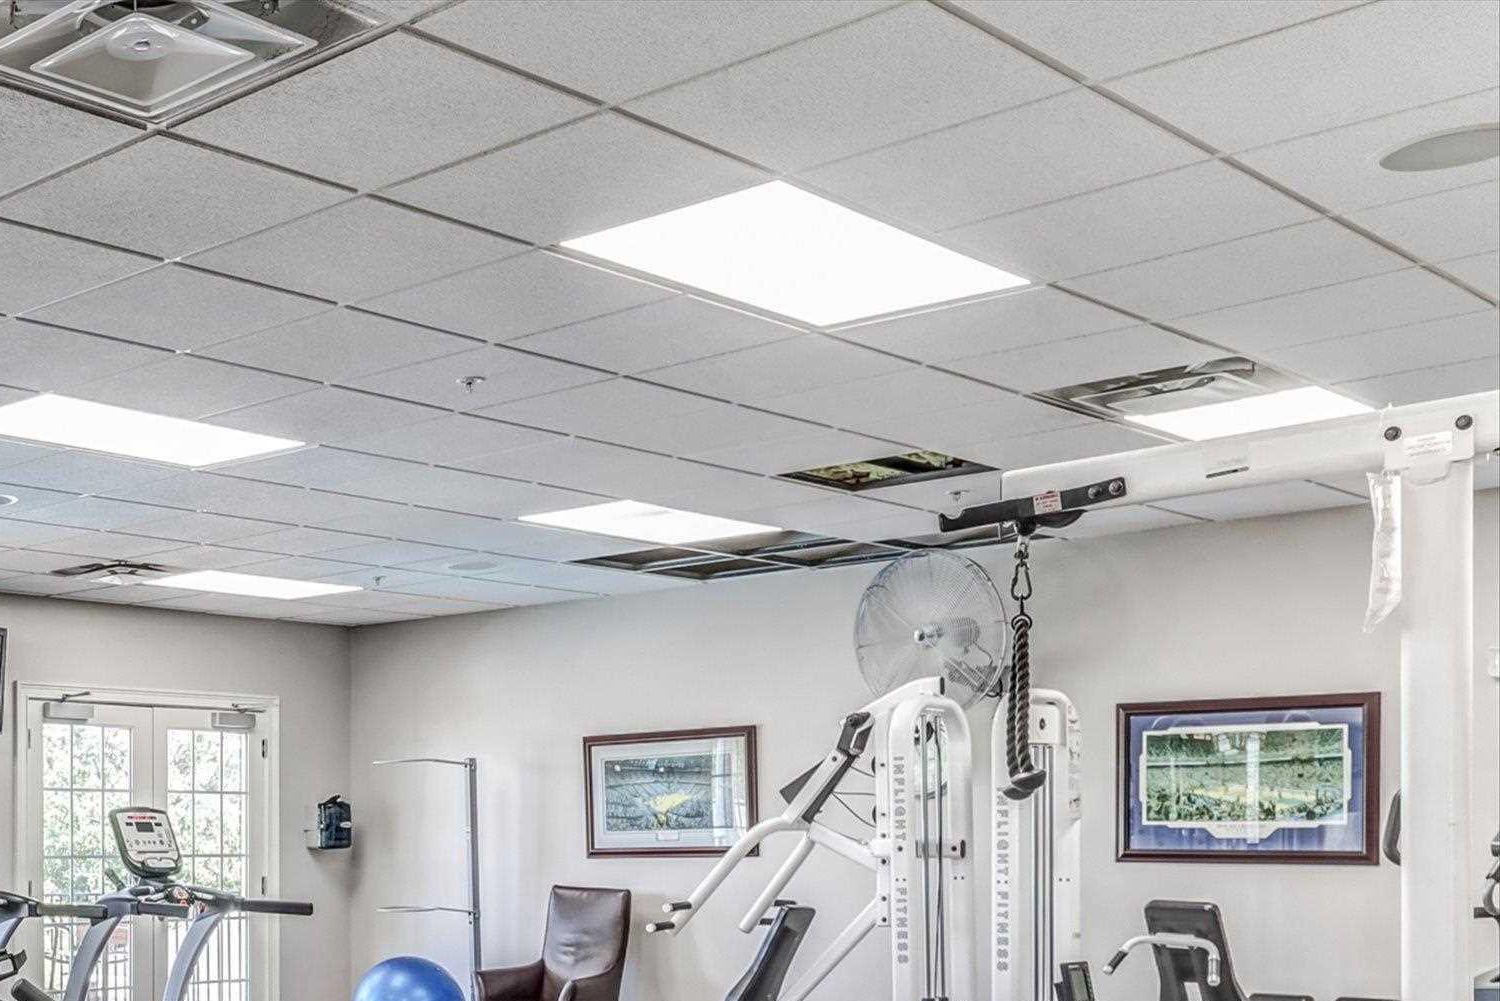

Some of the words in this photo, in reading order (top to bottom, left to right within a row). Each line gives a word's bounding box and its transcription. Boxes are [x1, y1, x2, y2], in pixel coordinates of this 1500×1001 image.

[893, 756, 906, 840] INFLIGHT
[896, 887, 908, 964] FITNESS
[996, 891, 1009, 971] FITNESS
